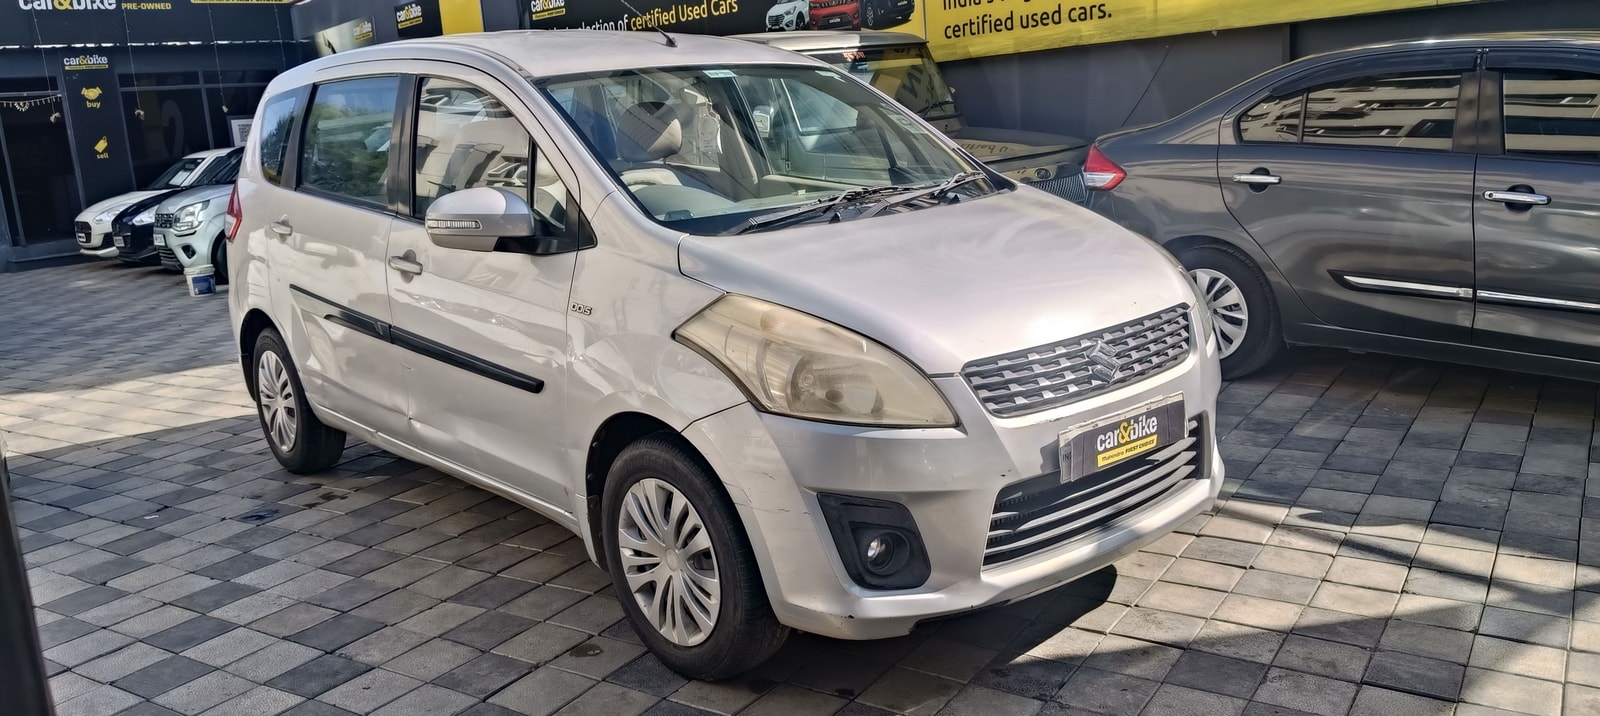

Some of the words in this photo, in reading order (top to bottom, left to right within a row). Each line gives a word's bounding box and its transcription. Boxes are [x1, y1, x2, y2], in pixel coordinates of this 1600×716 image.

[121, 2, 172, 10] PRE-OWNED
[630, 4, 676, 31] certified
[678, 0, 708, 22] Used
[711, 0, 738, 16] Cars
[944, 10, 1014, 39] certified
[1019, 3, 1062, 30] used
[1067, 3, 1112, 23] cars.
[63, 54, 108, 65] car&bike
[86, 100, 101, 109] buy
[96, 152, 109, 160] sell
[1096, 415, 1158, 452] car&bike
[1062, 451, 1072, 463] IN
